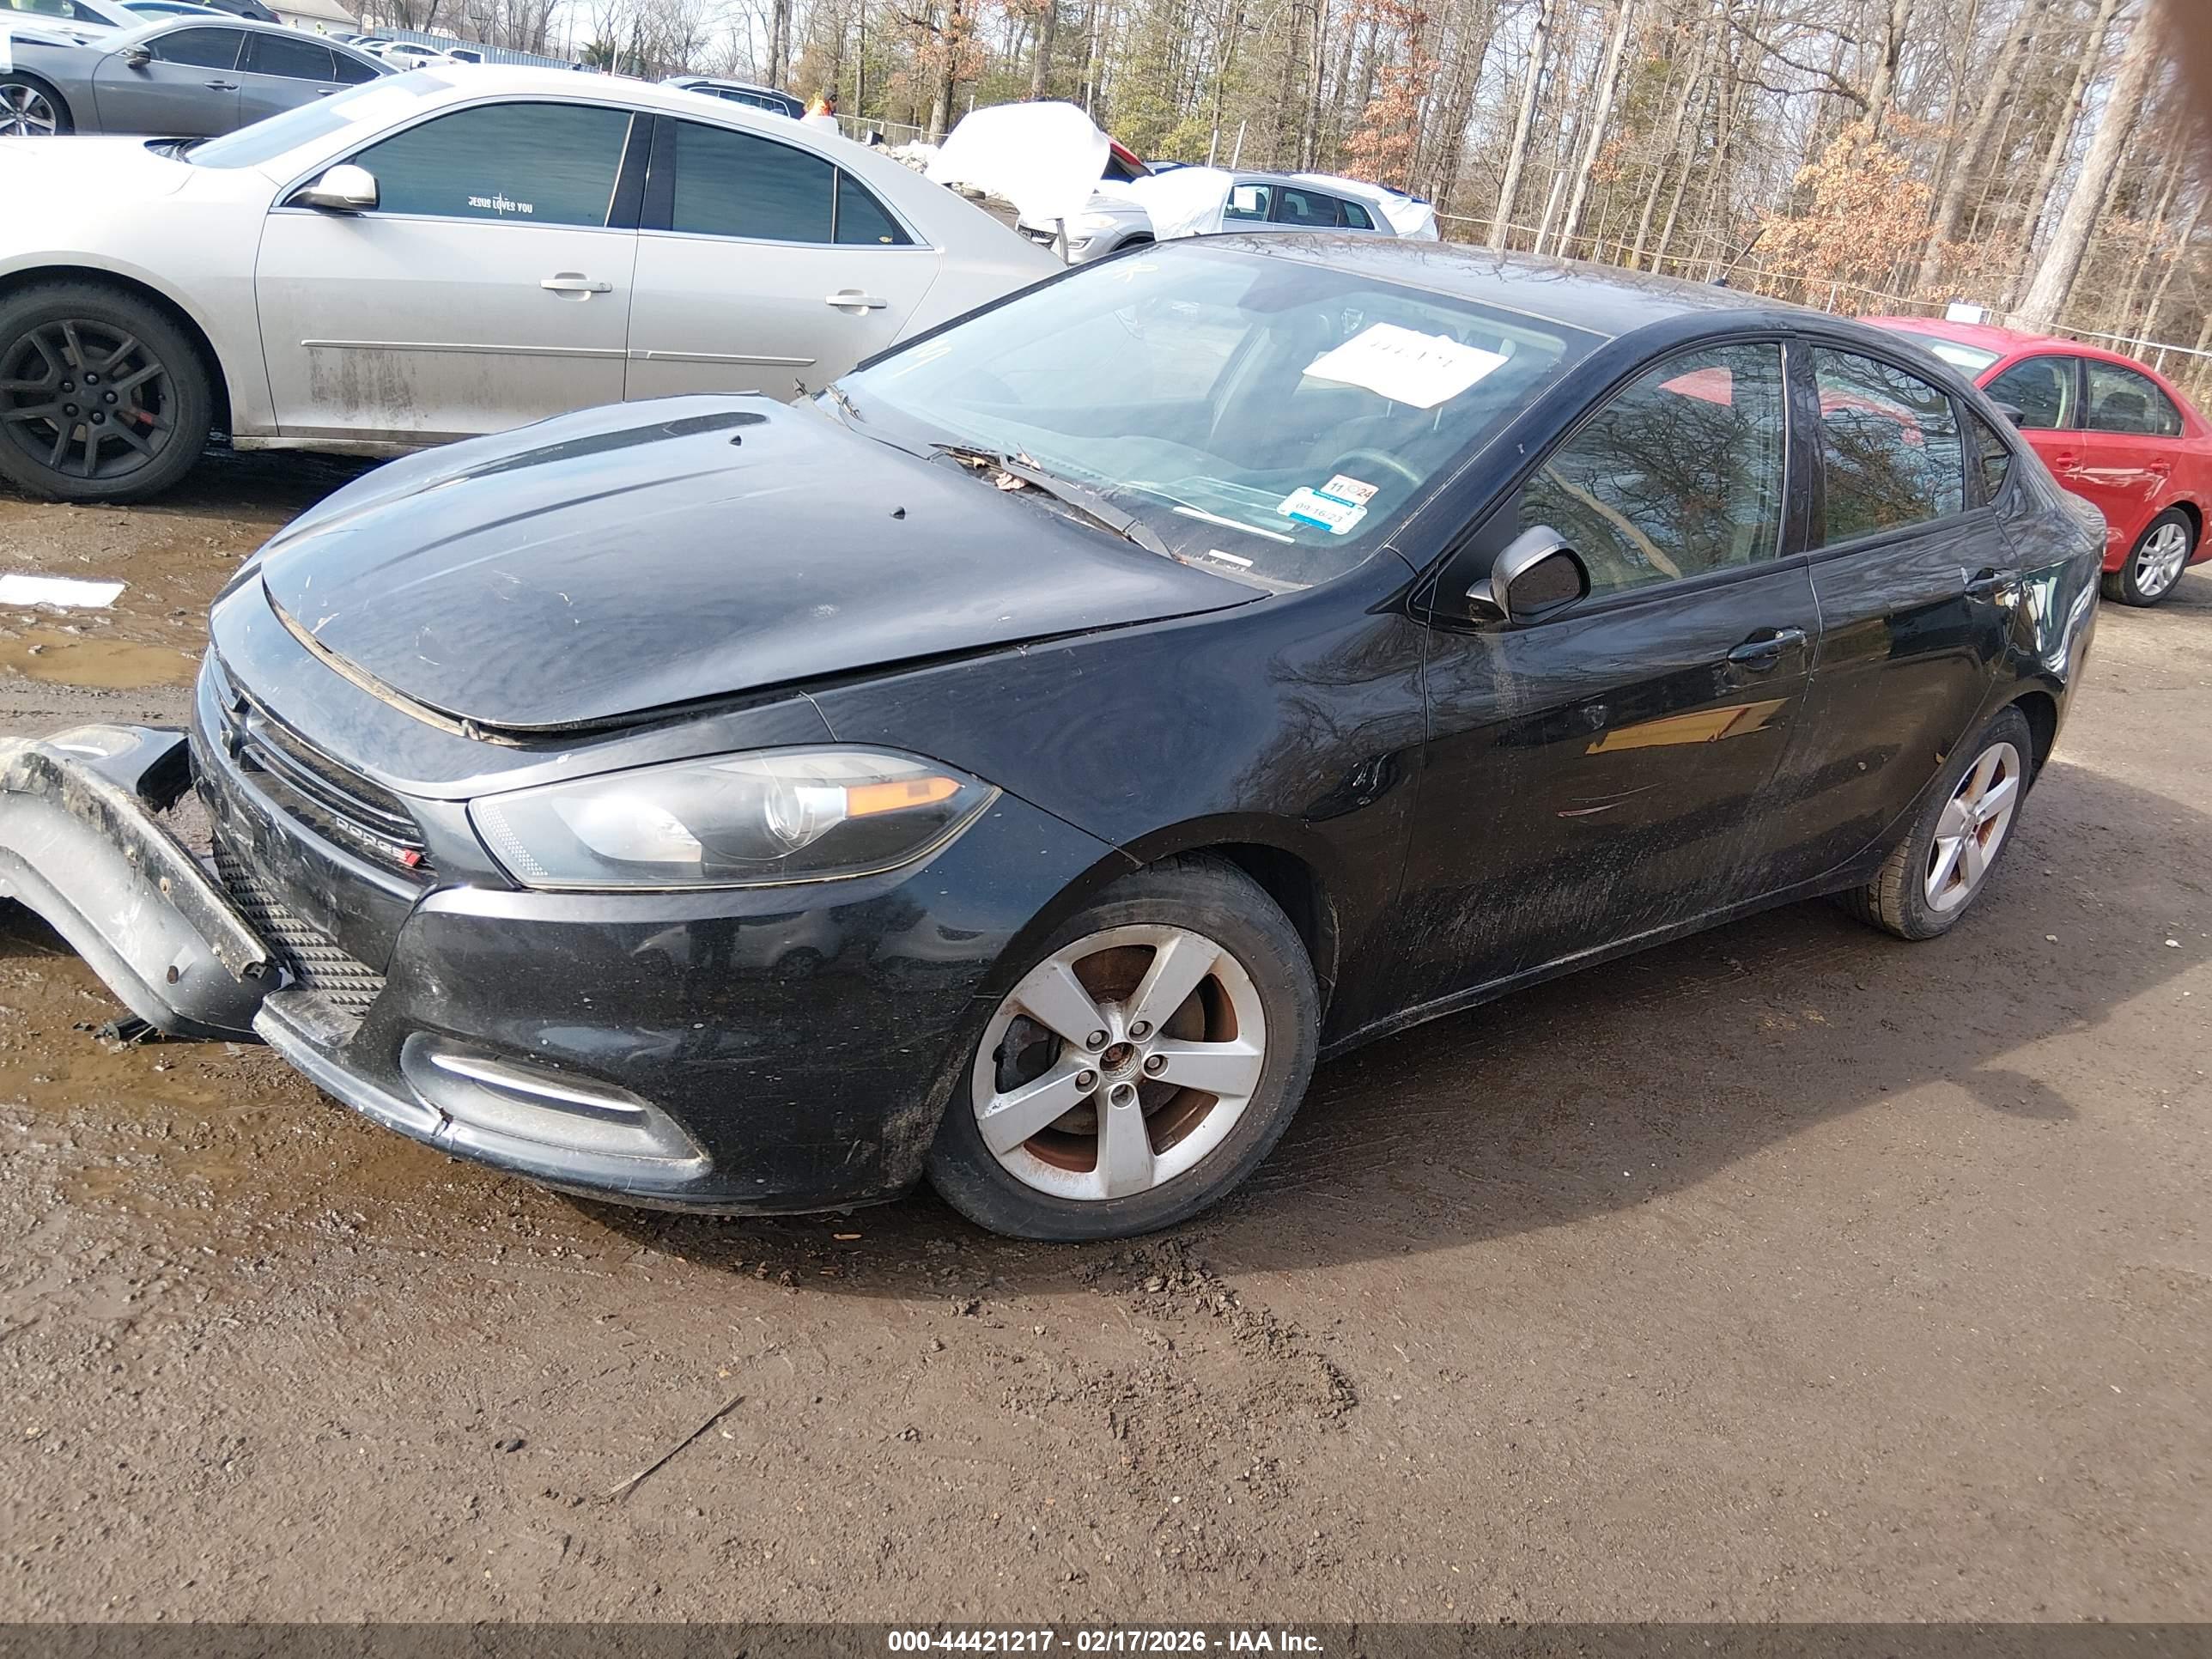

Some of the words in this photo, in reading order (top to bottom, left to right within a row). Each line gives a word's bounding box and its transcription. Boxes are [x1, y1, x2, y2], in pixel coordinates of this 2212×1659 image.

[468, 196, 491, 209] JESUS
[492, 195, 516, 213] LOVES
[517, 203, 533, 214] YOU
[1329, 482, 1345, 493] 11
[1357, 488, 1374, 499] 24
[336, 817, 408, 861] DODGE
